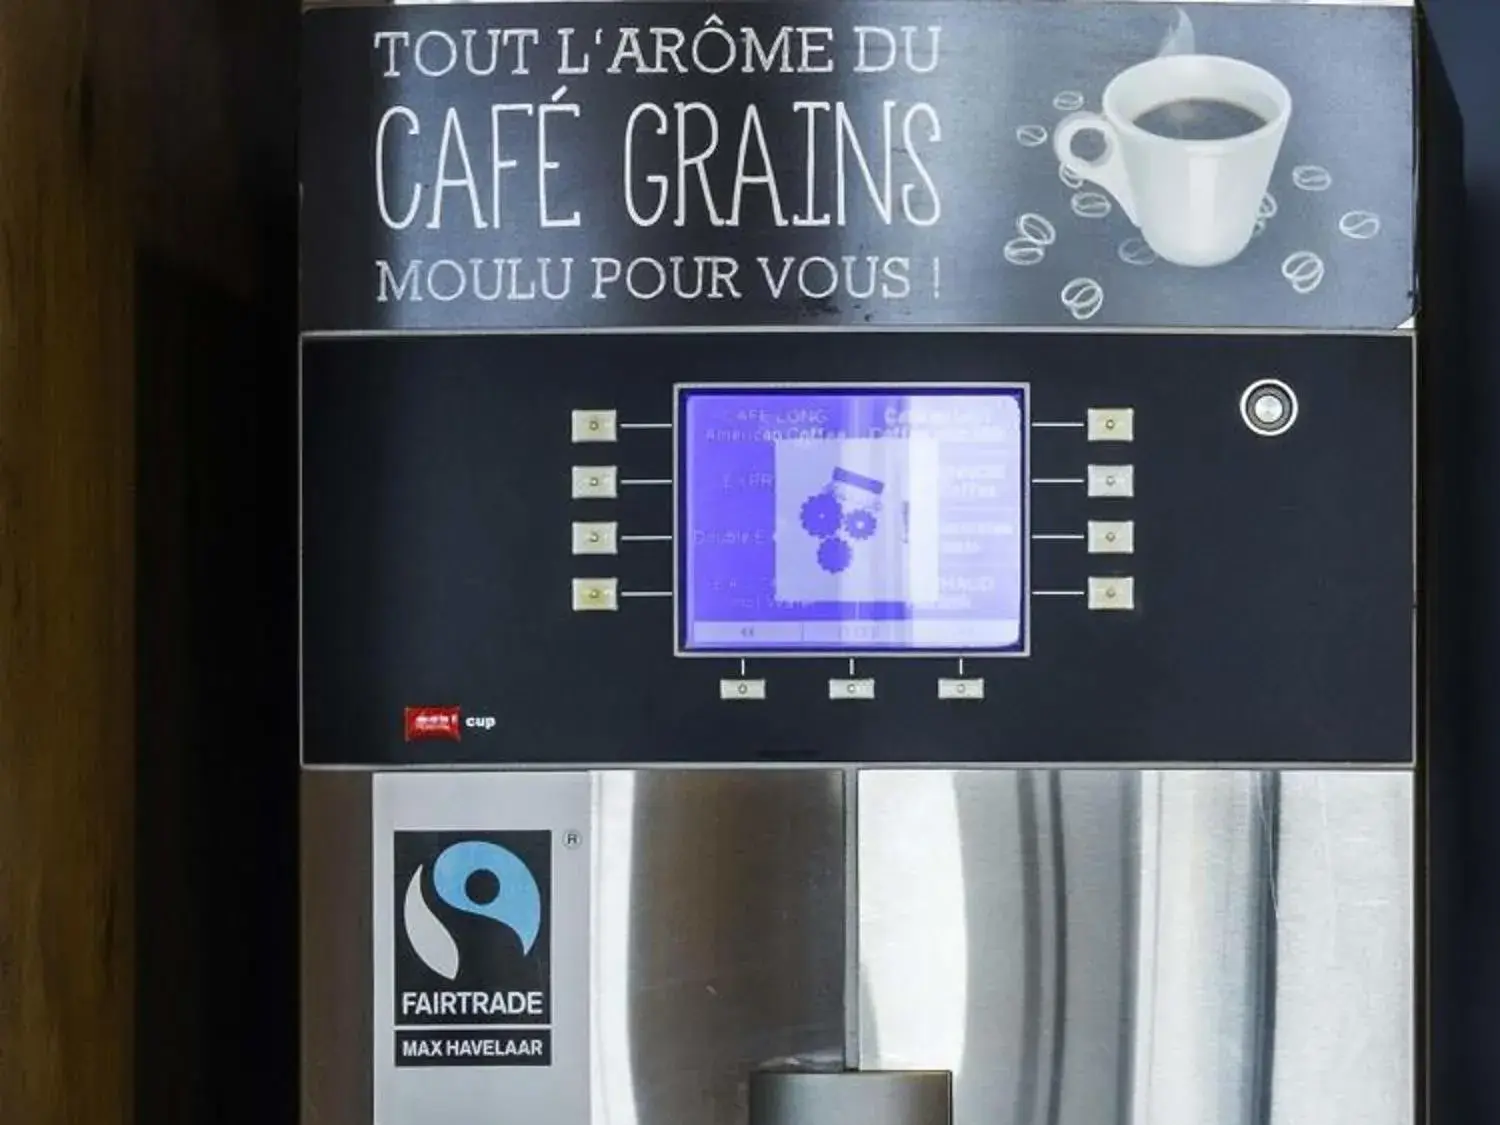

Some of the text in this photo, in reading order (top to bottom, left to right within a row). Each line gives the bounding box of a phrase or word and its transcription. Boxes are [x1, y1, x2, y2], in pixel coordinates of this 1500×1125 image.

[374, 14, 941, 77] TOUT L'ARÔME DU
[375, 85, 941, 229] CAFÉ GRAINS
[375, 257, 573, 303] MOULU
[591, 256, 741, 300] POUR
[757, 256, 911, 300] VOUS
[465, 716, 496, 731] cup
[402, 992, 543, 1016] FAIRTRADE
[402, 1039, 543, 1057] MAX HAVELAAR
